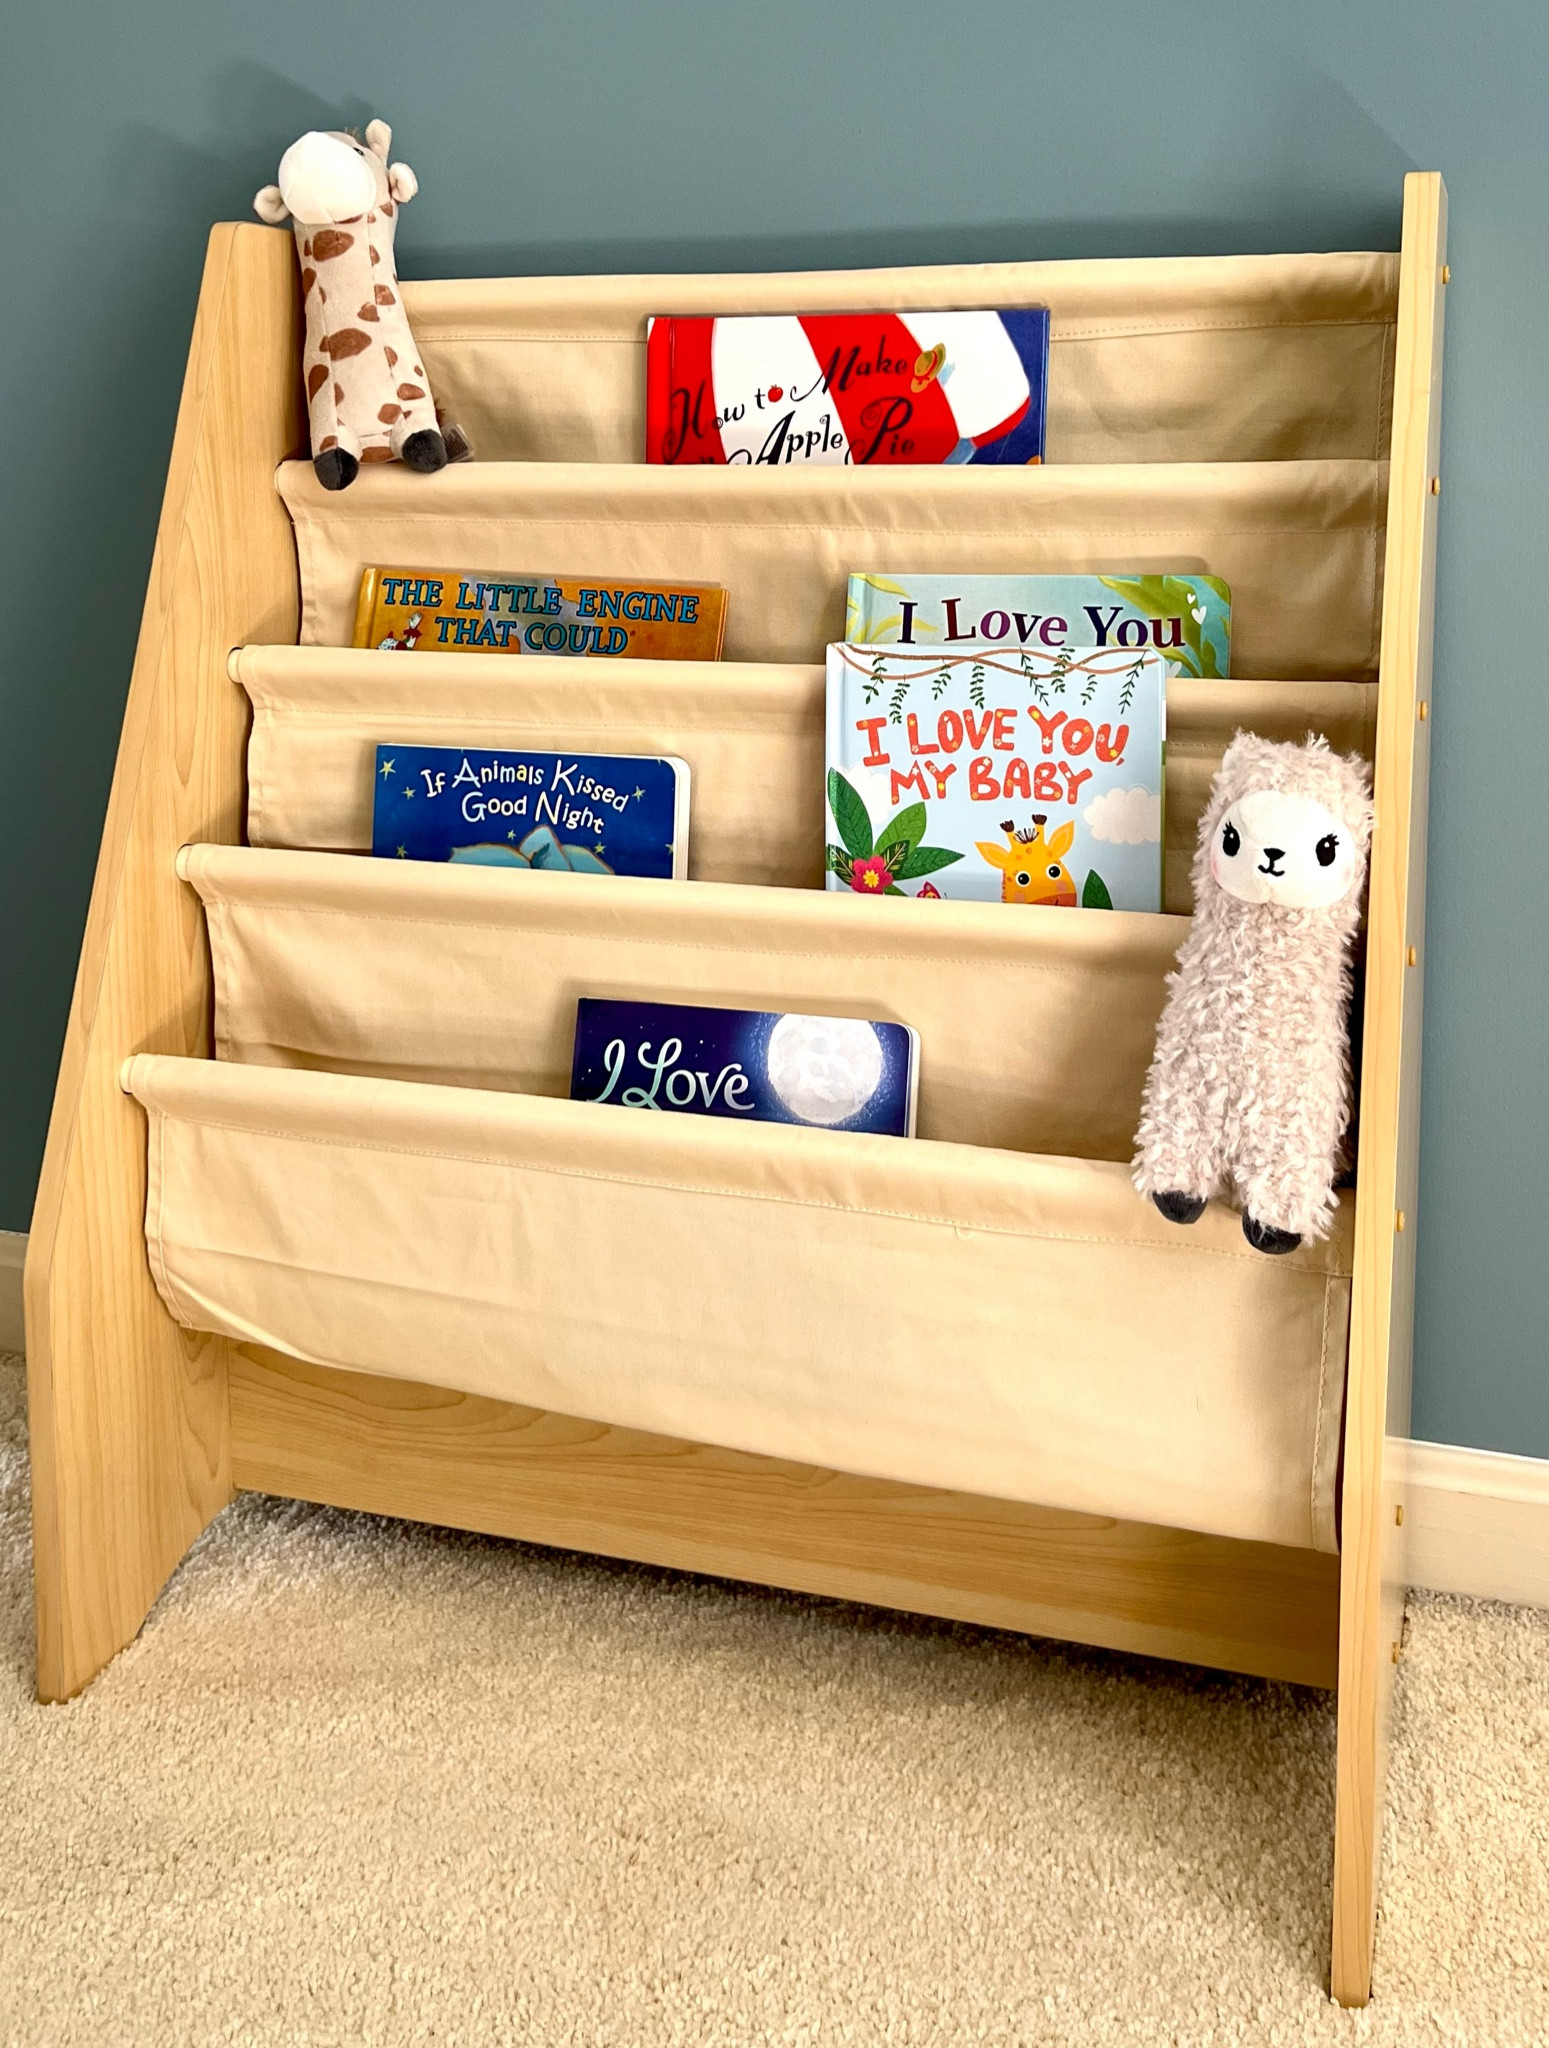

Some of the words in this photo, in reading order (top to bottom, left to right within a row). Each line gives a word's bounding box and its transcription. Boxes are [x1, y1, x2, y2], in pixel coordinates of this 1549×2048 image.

[662, 379, 746, 465] How
[790, 334, 908, 402] Make
[727, 410, 843, 465] Apple
[844, 396, 914, 465] Pie
[382, 578, 443, 608] THE
[455, 583, 562, 615] LITTLE
[576, 591, 699, 623] ENGINE
[896, 601, 918, 644] I
[941, 598, 1068, 647] Love
[1083, 606, 1186, 648] You
[434, 617, 517, 647] THAT
[524, 622, 628, 654] COULD
[856, 717, 890, 767] I
[906, 708, 1018, 755] LOVE
[1026, 704, 1130, 766] YOU,
[420, 769, 446, 797] If
[451, 758, 544, 789] Animals
[550, 759, 630, 813] Kissed
[890, 759, 957, 806] MY
[969, 755, 1093, 805] BABY
[461, 791, 527, 823] Good
[534, 791, 605, 835] Night
[586, 1038, 626, 1103] I
[622, 1037, 755, 1111] Love
